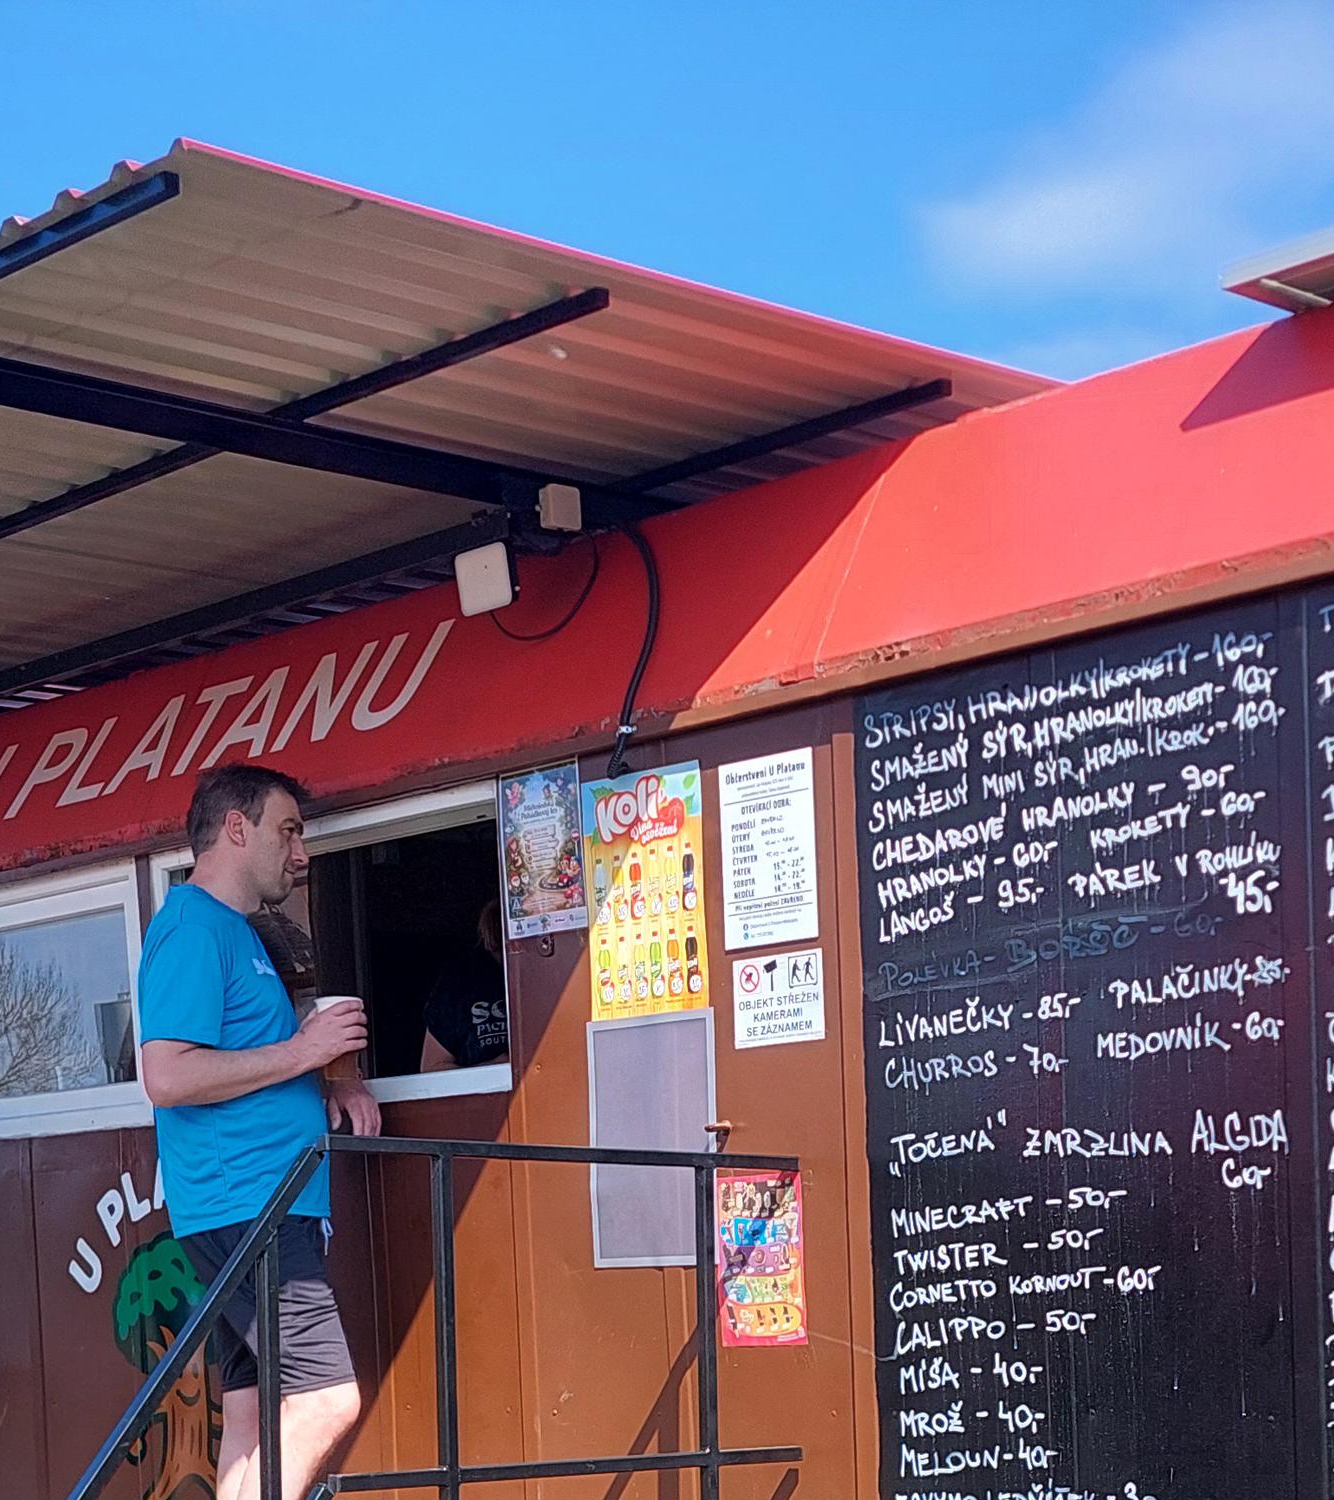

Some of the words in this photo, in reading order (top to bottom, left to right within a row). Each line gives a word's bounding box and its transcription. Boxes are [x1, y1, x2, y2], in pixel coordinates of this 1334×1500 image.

[3, 618, 455, 820] PLATANU
[871, 733, 969, 792] SMAŽENÝ
[868, 772, 969, 834] SMAŽENÝ
[982, 772, 1025, 800] MINI
[1091, 803, 1191, 848] KROKETY
[872, 802, 1006, 871] CHEDAROVÉ
[1022, 781, 1135, 832] HRANOLKY
[878, 854, 986, 909] HRANOLKY
[879, 891, 955, 943] LANGOŠ
[739, 998, 774, 1011] OBJEKT
[777, 992, 819, 1006] STŘEŽEN
[1108, 958, 1248, 1009] PALAČINKY
[747, 1027, 758, 1037] SE
[761, 1020, 812, 1035] ZÁZNAMEM
[754, 1008, 802, 1022] KAMERAMI
[879, 996, 1013, 1047] LÍVANEČKY
[1097, 1012, 1231, 1060] MEDOVNÍK
[885, 1050, 998, 1090] CHURROS
[1022, 1127, 1173, 1158] ZMRZLINA
[890, 1195, 1034, 1239] MINECRAFT
[68, 1237, 102, 1293] U
[894, 1243, 1008, 1276] TWISTER
[889, 1273, 998, 1313] CORNETTO
[1009, 1266, 1097, 1293] KORNOUT
[895, 1320, 1006, 1355] CALIPPO
[900, 1359, 960, 1395] MÍŠA
[900, 1402, 965, 1437] MROŽ
[900, 1444, 999, 1478] MELOUN
